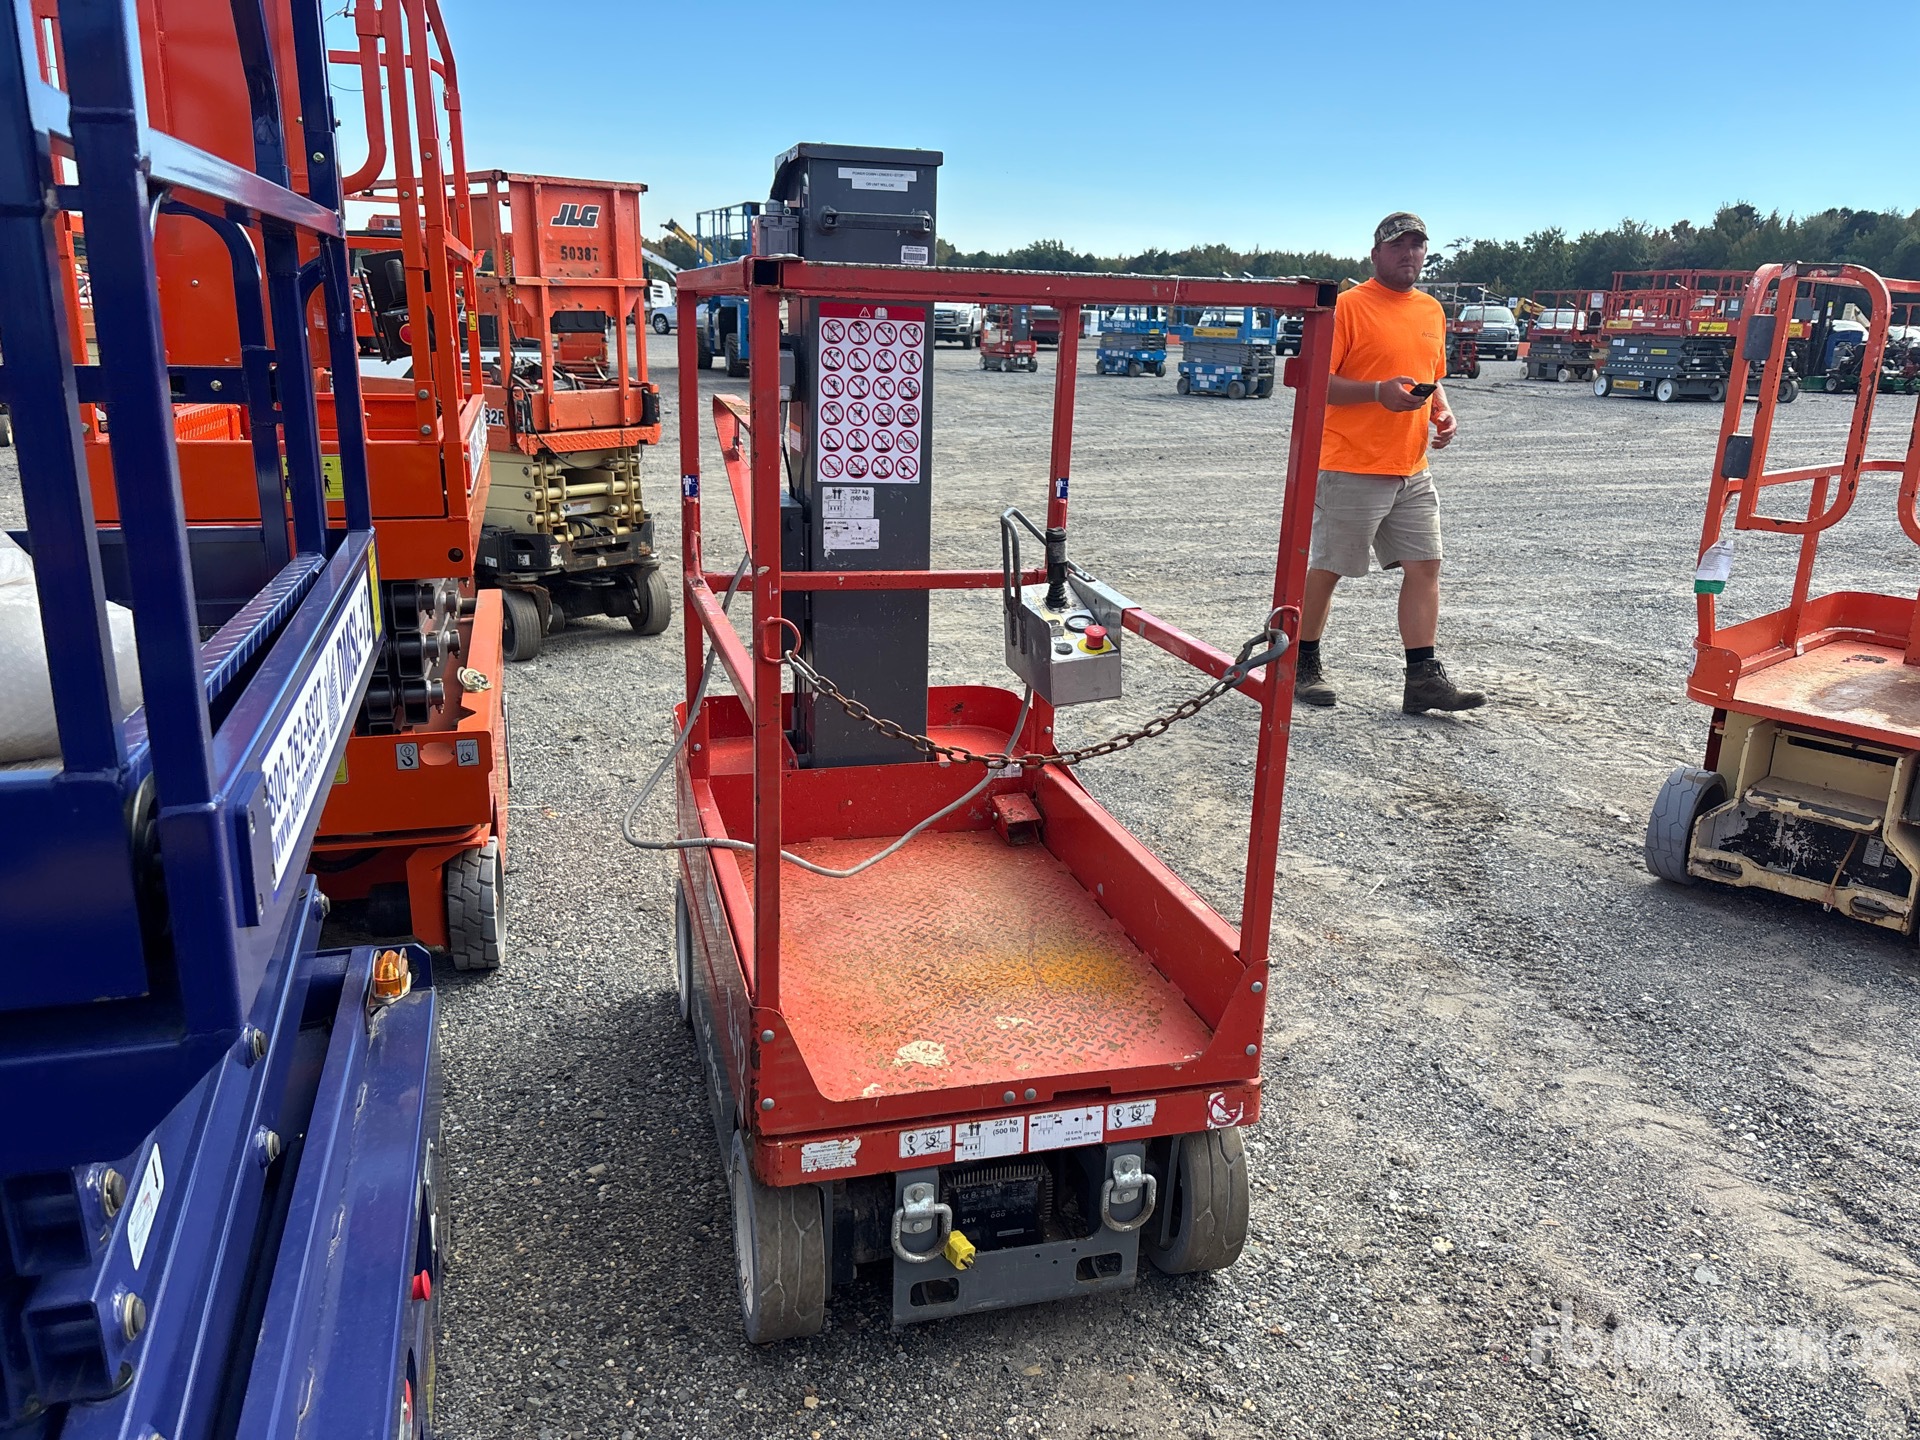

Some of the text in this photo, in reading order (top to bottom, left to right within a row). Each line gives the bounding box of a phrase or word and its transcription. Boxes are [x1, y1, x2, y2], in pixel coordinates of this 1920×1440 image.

[550, 203, 601, 228] JLG
[561, 245, 599, 261] 50387
[336, 585, 373, 706] DMSL-12
[266, 676, 324, 826] 800-762-8327
[272, 726, 328, 864] www.ballymore.com
[992, 1126, 1019, 1137] (500 lb)
[994, 1118, 1018, 1127] 227 kg
[962, 1216, 977, 1225] 24 V
